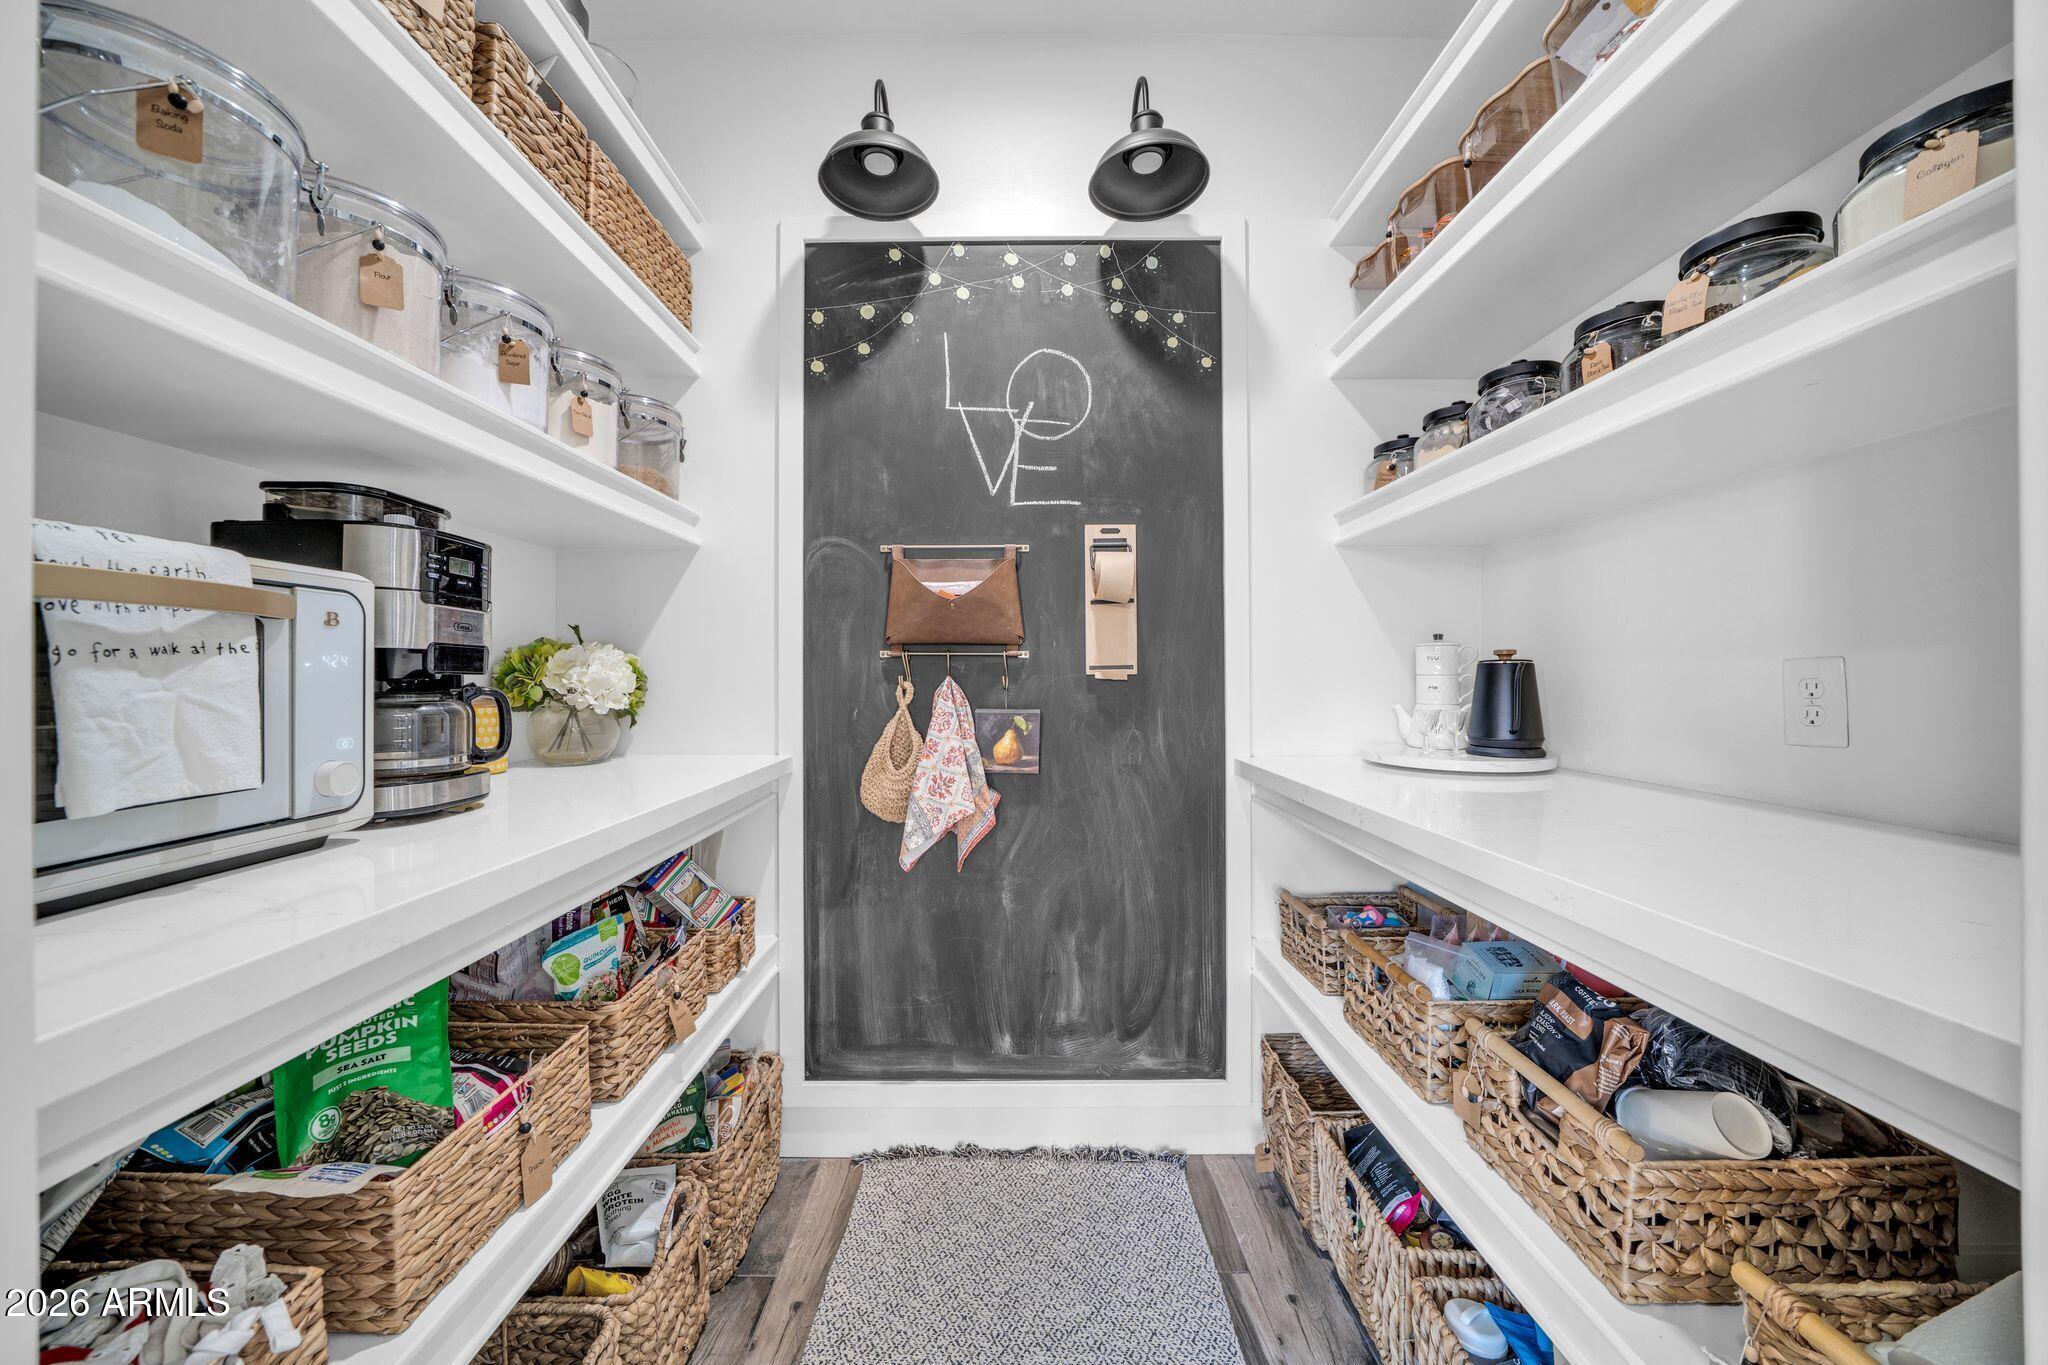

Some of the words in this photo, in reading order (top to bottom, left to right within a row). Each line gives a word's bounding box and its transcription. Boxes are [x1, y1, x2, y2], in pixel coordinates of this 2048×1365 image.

[150, 103, 189, 125] Baking
[156, 118, 183, 134] Soda
[1916, 153, 1965, 180] Collagen
[373, 271, 392, 281] Flour
[43, 598, 81, 614] ove
[52, 645, 77, 667] go
[91, 641, 118, 663] for
[129, 652, 139, 660] a
[149, 640, 181, 656] walk
[191, 640, 206, 655] at
[216, 642, 251, 654] the
[1548, 999, 1561, 1012] ARK
[1574, 986, 1597, 1006] COFFEE
[326, 1031, 398, 1063] SEEDS
[336, 1062, 359, 1074] SEA
[360, 1053, 387, 1066] SALT
[327, 1083, 342, 1095] JUST
[347, 1067, 398, 1085] INGREDIENTS
[601, 1188, 622, 1202] EGG
[602, 1191, 633, 1209] WHITE
